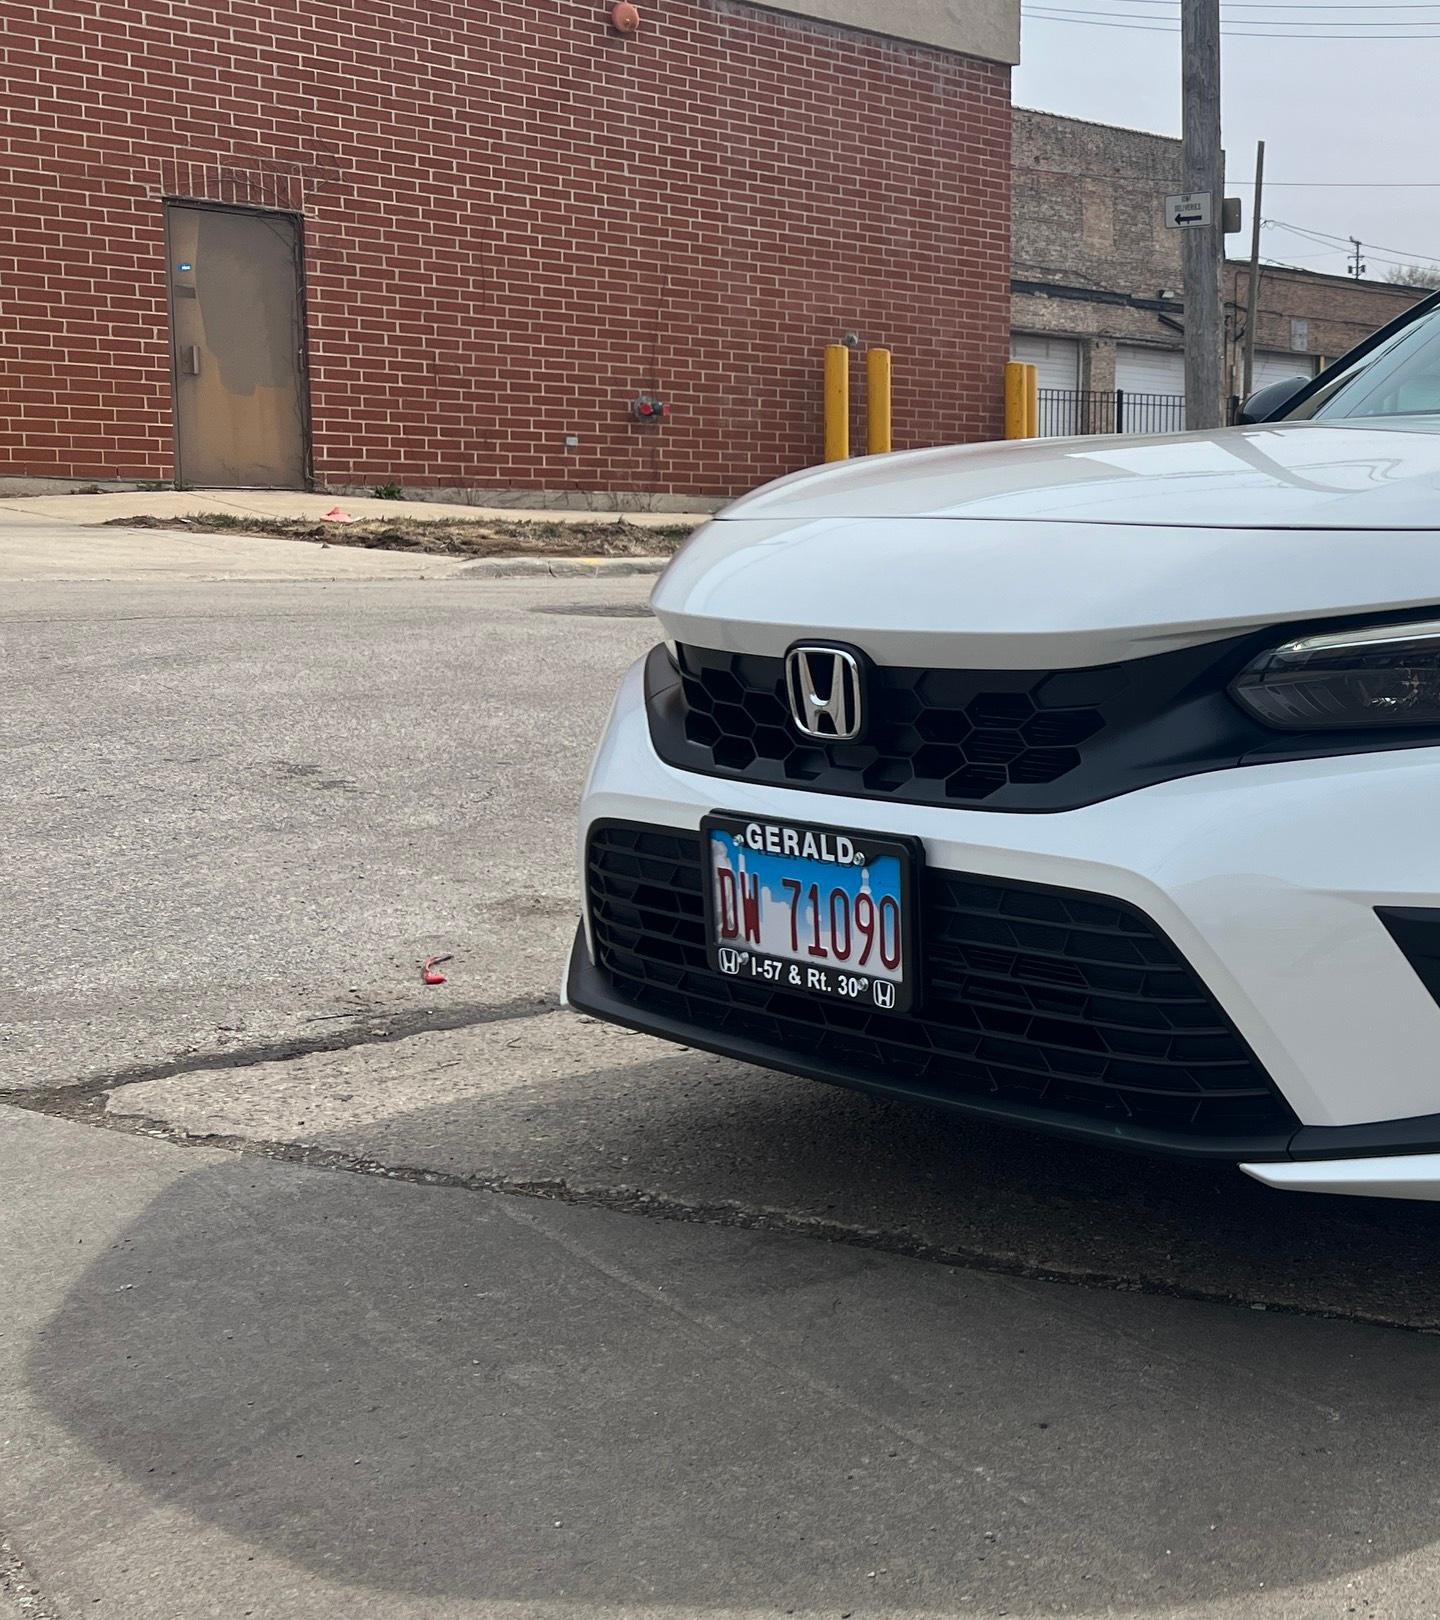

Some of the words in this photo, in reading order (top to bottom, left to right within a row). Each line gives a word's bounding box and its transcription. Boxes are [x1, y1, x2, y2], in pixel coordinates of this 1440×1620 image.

[745, 823, 854, 865] GERALD
[718, 867, 761, 944] DW
[782, 878, 901, 970] 71090
[752, 957, 782, 980] I-57
[788, 965, 802, 985] &
[807, 969, 832, 992] Rt.
[838, 976, 858, 998] 30
